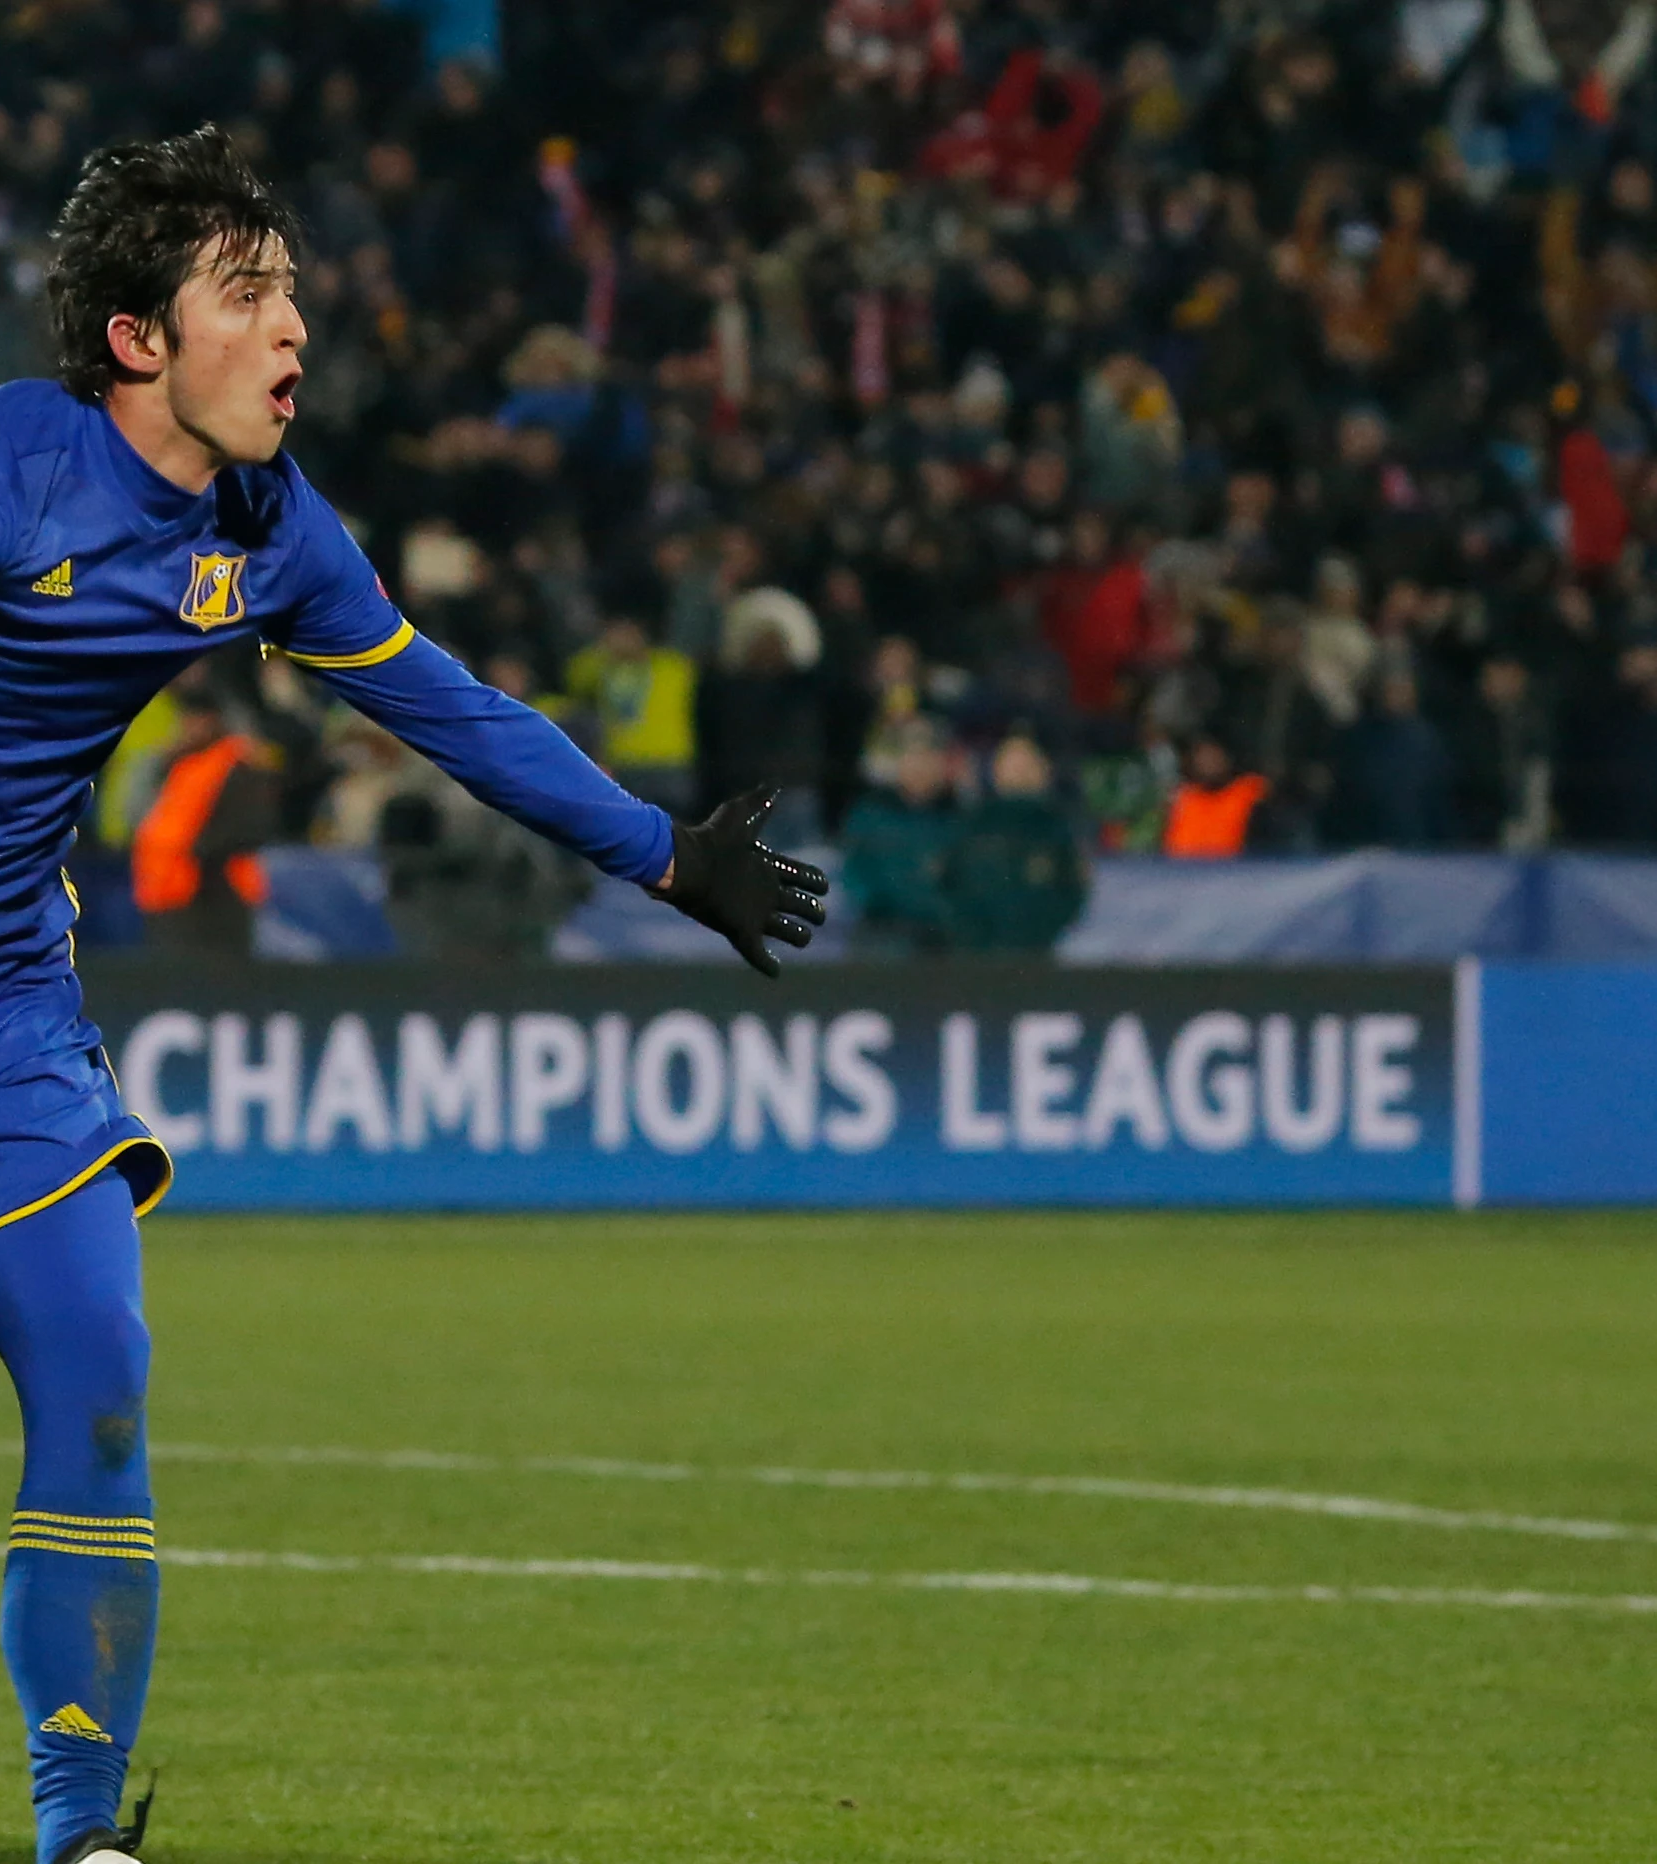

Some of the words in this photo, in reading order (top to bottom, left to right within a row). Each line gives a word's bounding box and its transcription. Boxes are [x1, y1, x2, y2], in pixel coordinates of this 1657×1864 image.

[32, 581, 73, 597] adidas
[121, 1010, 897, 1153] CHAMPIONS
[942, 1010, 1420, 1153] LEAGUE
